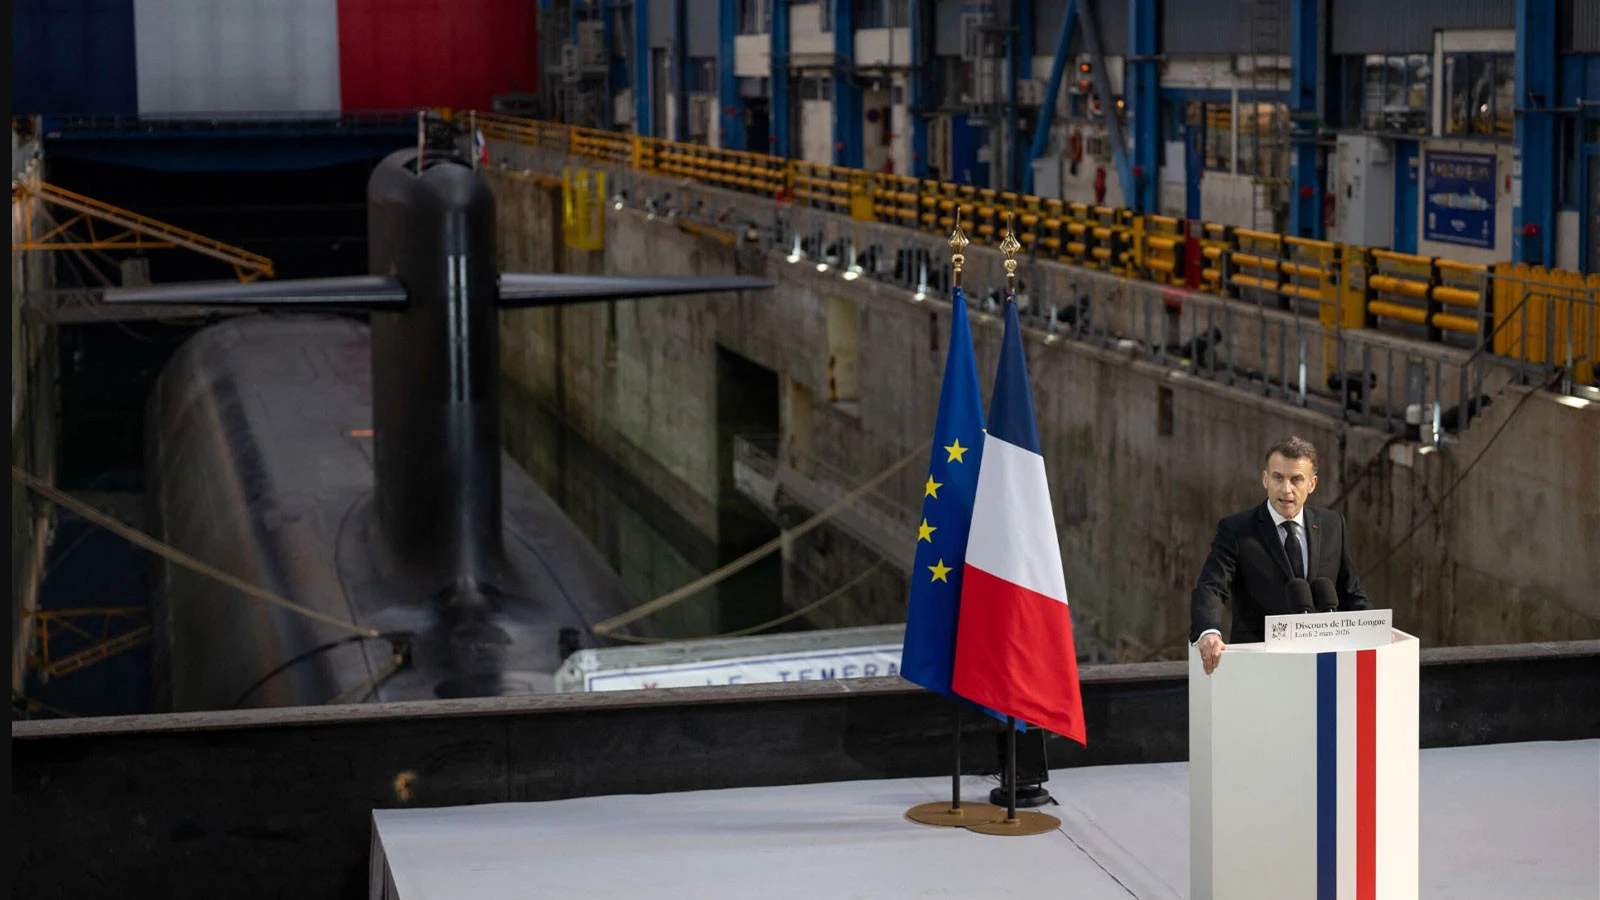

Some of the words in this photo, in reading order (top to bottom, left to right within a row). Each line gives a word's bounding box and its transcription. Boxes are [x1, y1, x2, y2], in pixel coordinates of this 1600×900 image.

[1295, 621, 1329, 630] Discours
[1330, 619, 1340, 628] de
[1358, 618, 1386, 628] Longue
[1295, 630, 1313, 639] Lundi
[1314, 630, 1319, 638] 2
[1335, 629, 1350, 637] 2026
